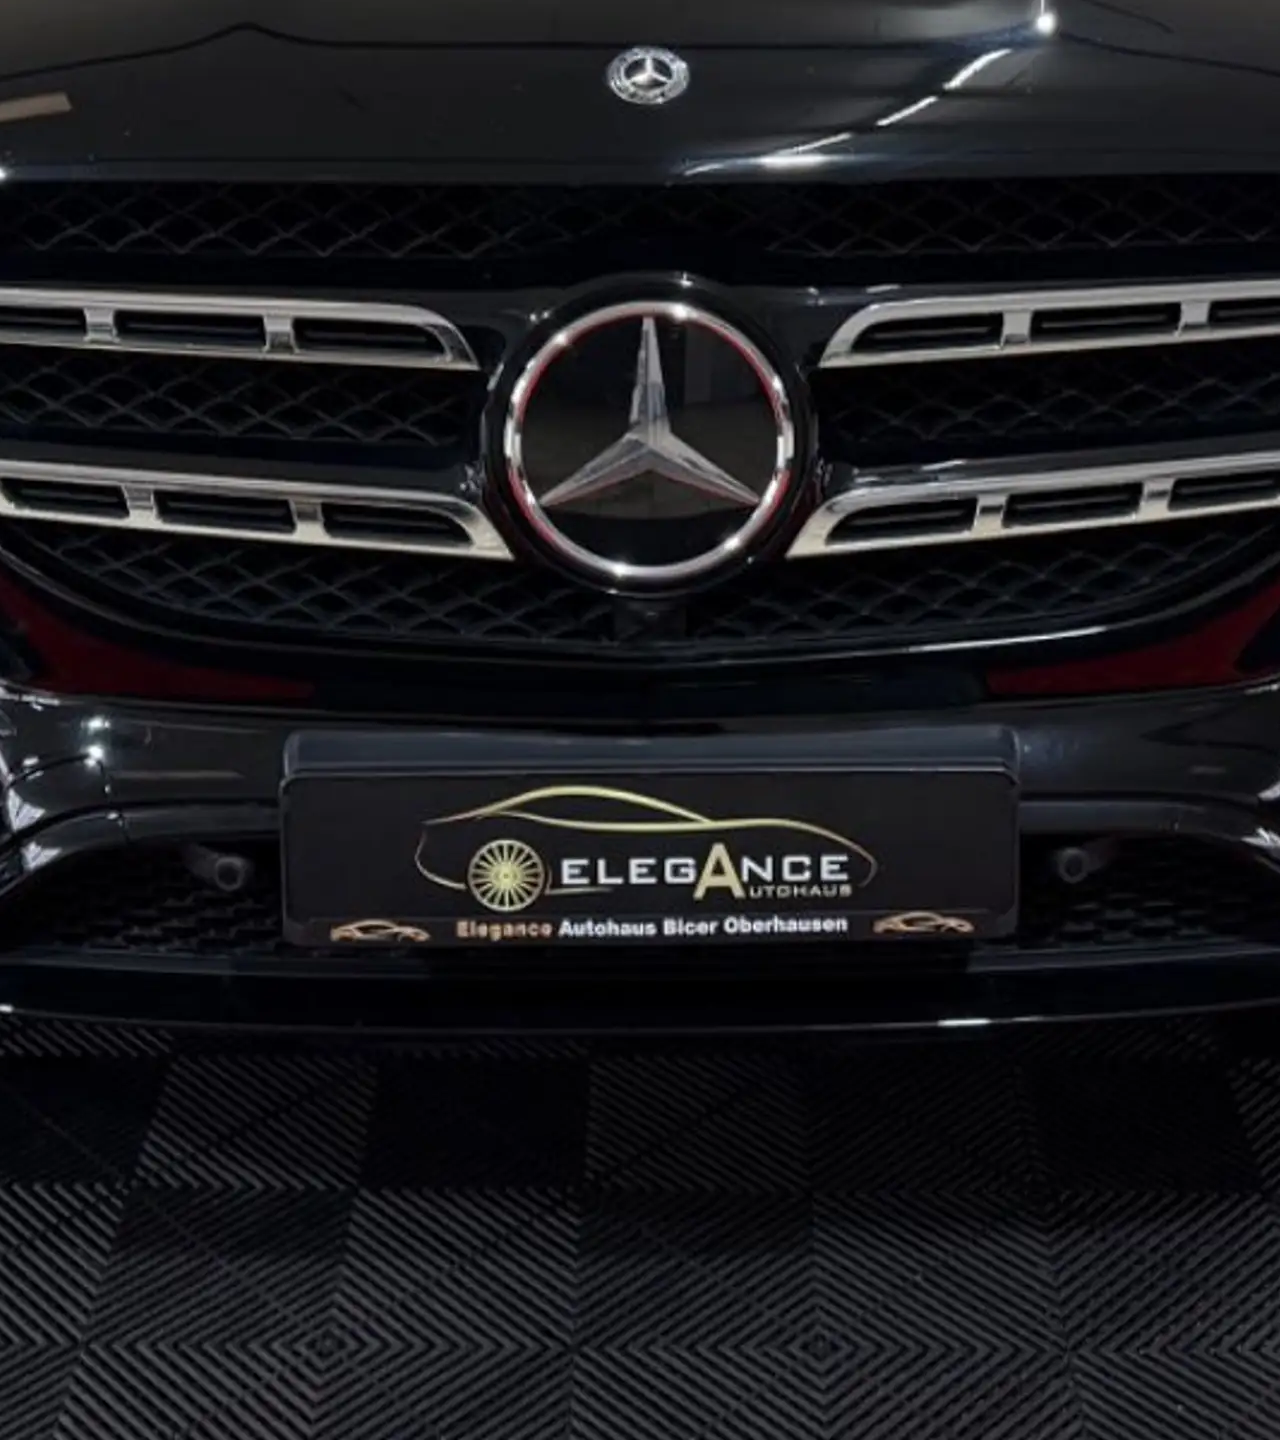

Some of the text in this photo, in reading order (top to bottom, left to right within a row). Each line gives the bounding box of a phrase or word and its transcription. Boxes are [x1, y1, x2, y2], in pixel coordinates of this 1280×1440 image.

[560, 843, 849, 900] ELEGANCE
[456, 914, 848, 941] Elegance Autohaus Bicer Oberhausen
